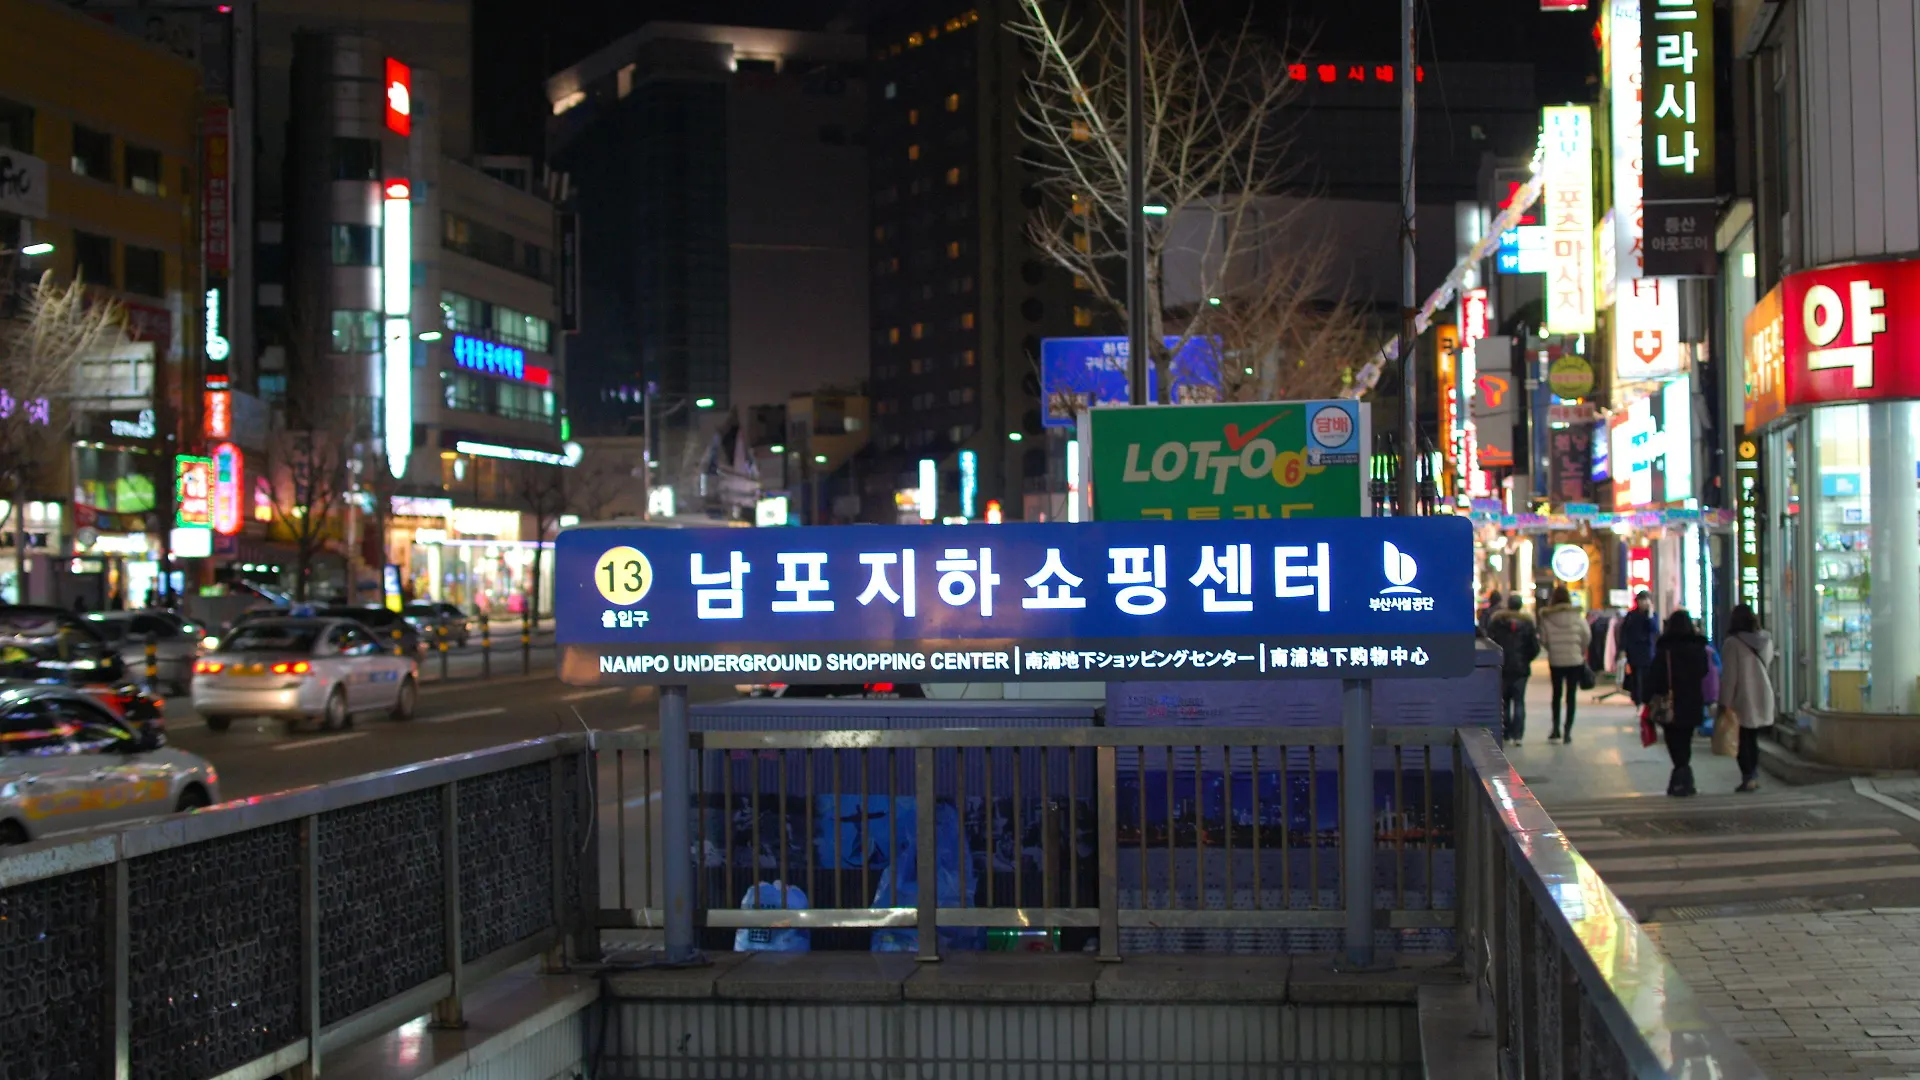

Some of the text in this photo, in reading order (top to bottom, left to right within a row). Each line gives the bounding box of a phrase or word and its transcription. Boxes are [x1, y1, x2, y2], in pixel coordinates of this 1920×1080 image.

[1803, 280, 1886, 389] 약
[1315, 416, 1349, 433] 담배
[1122, 438, 1277, 495] LOTTO
[601, 561, 643, 593] 13
[600, 609, 650, 628] 출입구
[599, 651, 1010, 673] NAMPO UNDERGROUND SHOPPING CENTER
[1024, 649, 1255, 670] 南浦地下ショッピングセンター
[1269, 646, 1430, 668] 南浦地下购物中心
